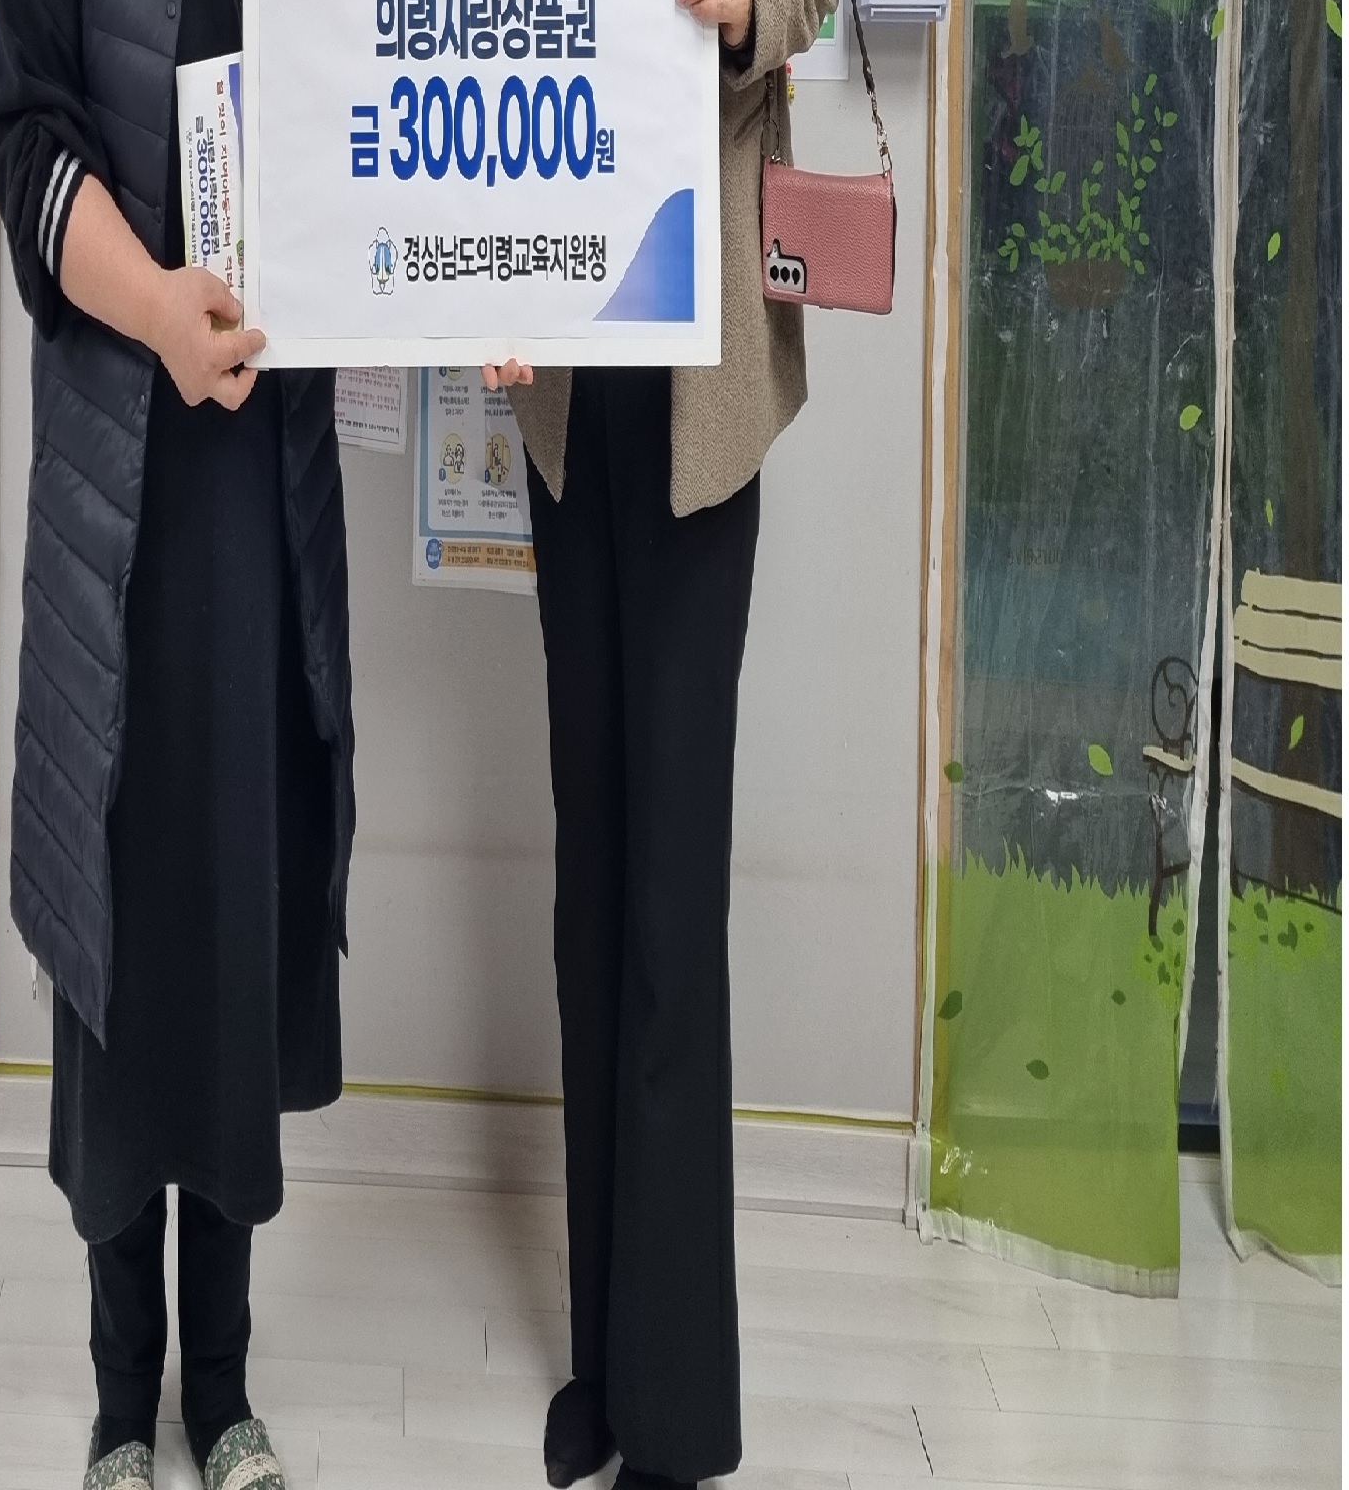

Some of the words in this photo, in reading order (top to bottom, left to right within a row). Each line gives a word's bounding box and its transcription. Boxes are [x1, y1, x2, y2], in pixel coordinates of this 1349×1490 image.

[350, 103, 379, 179] 금
[388, 73, 616, 189] 300,000원
[403, 232, 607, 283] 경상남도의령교육지원청
